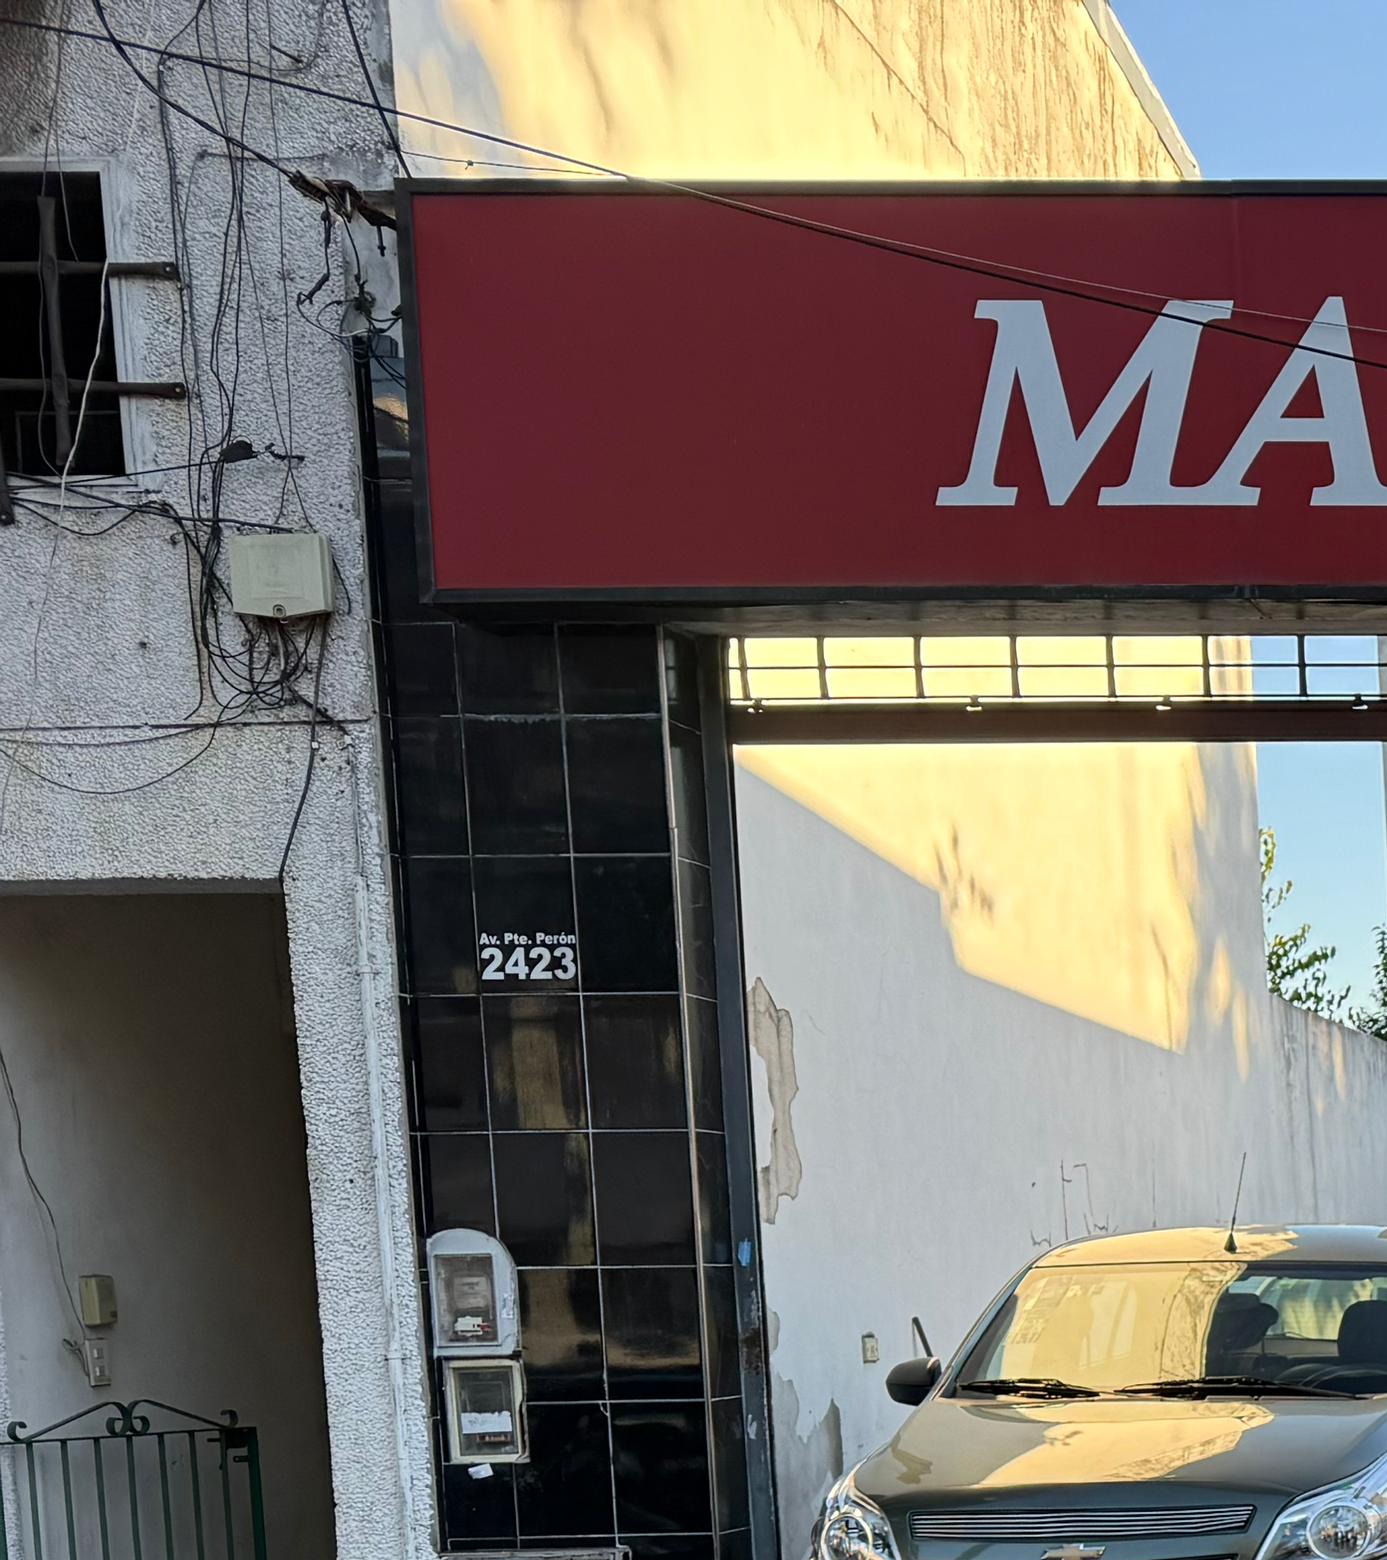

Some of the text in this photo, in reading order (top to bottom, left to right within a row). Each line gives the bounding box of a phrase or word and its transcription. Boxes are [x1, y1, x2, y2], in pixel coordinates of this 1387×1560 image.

[479, 931, 576, 945] Av. Pte. Perón
[480, 946, 576, 980] 2423
